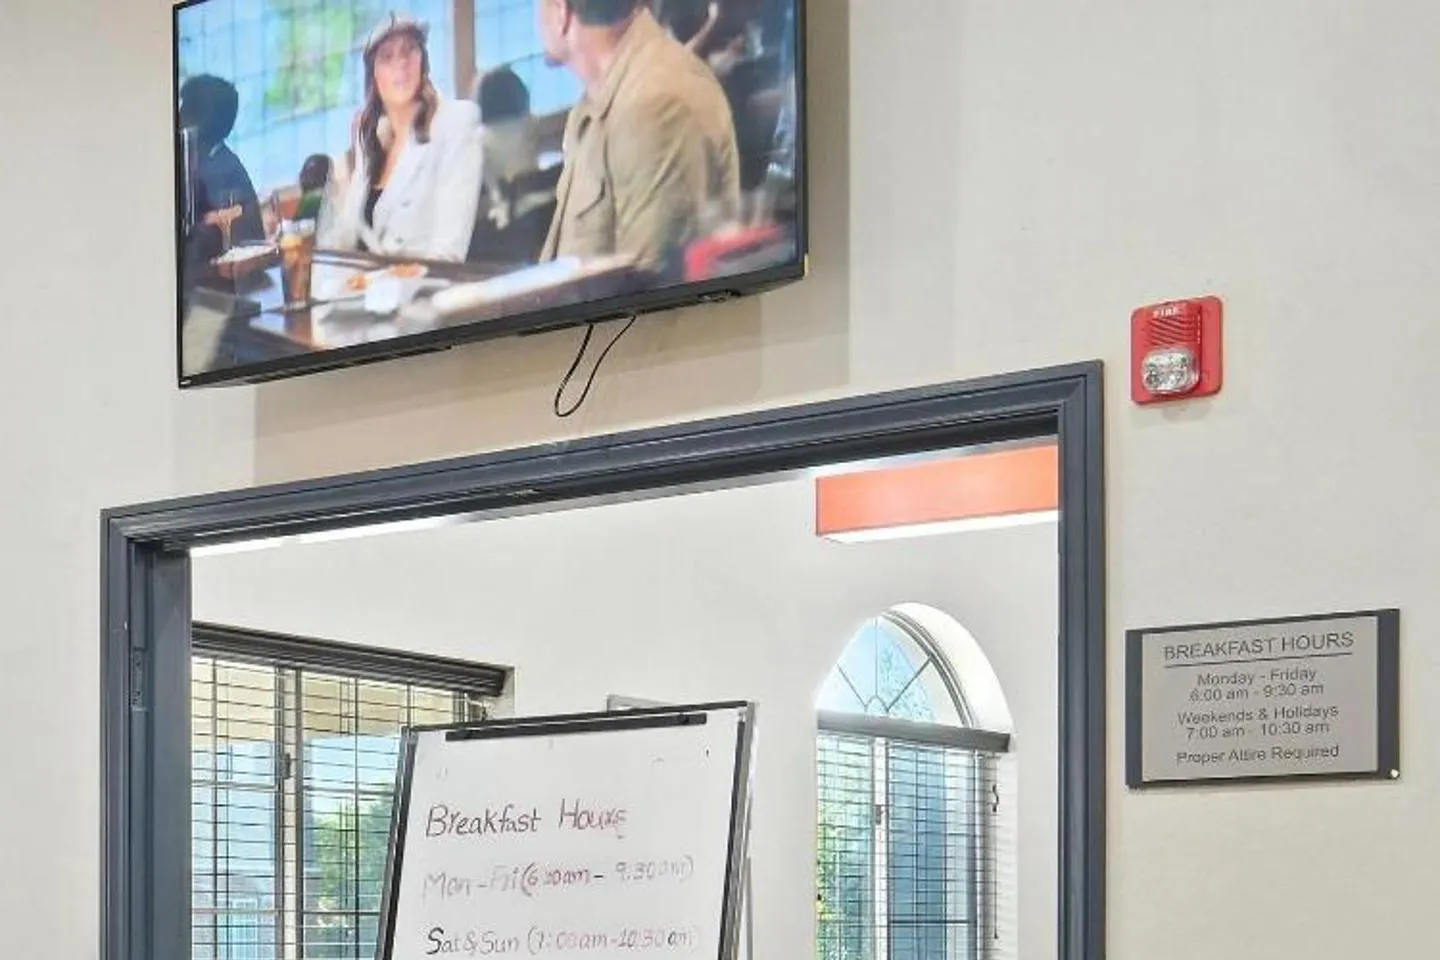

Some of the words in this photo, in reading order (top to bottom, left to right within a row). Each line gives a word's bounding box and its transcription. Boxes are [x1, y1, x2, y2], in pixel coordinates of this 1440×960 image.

[1163, 637, 1277, 660] BREAKFAST
[1281, 631, 1355, 652] HOURS
[1196, 671, 1254, 686] Monday
[1270, 667, 1316, 682] Friday
[1226, 689, 1249, 700] am
[1263, 682, 1296, 697] 9:30
[1300, 684, 1324, 696] am
[1177, 711, 1253, 726] Weekends
[1258, 707, 1268, 720] &
[1274, 705, 1339, 720] Holidays
[1222, 727, 1245, 738] am
[1262, 721, 1300, 736] 10:30
[1305, 722, 1330, 734] am
[1176, 751, 1225, 766] Proper
[1271, 744, 1339, 761] Required
[425, 803, 542, 838] Breakfast
